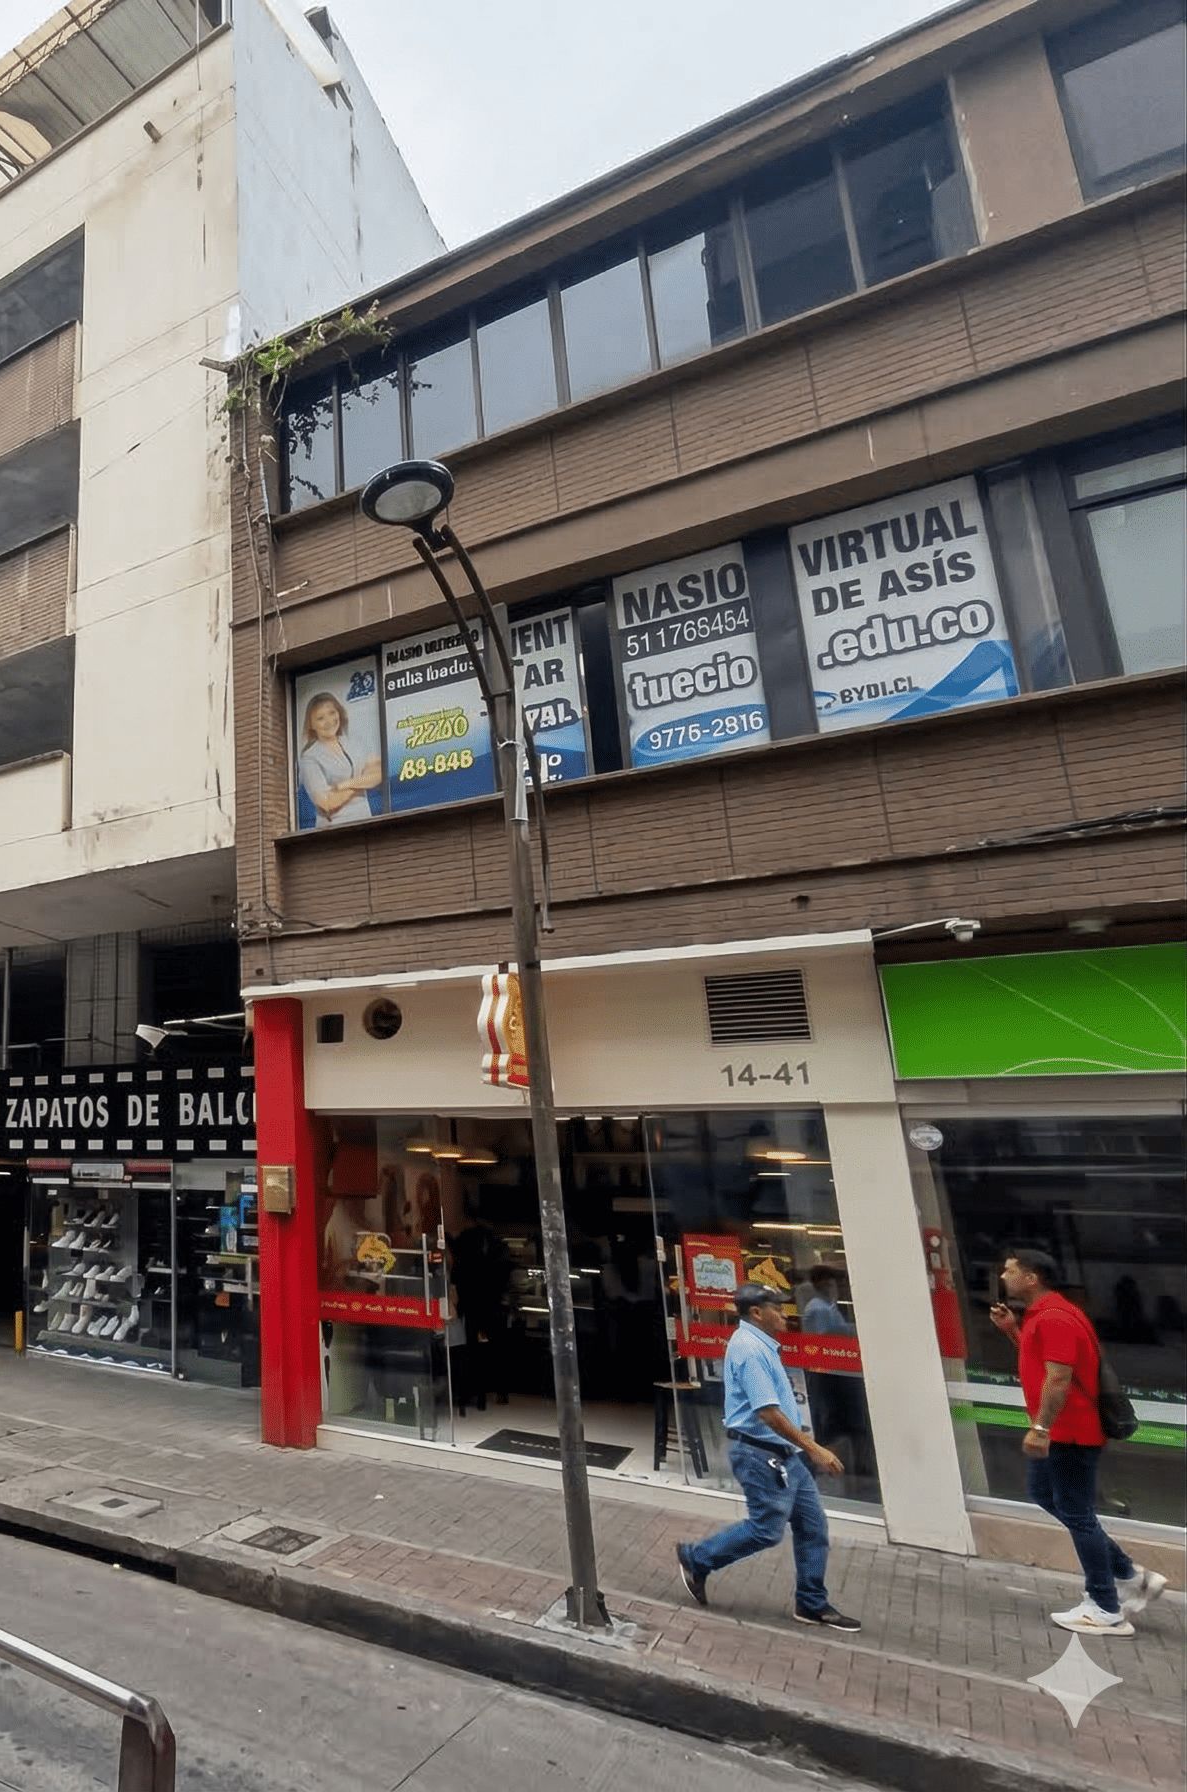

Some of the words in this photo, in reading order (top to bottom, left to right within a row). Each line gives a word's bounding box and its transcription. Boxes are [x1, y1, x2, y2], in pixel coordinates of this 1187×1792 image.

[797, 499, 979, 577] VIRTUAL
[622, 562, 746, 626] NASIO
[811, 578, 865, 617] DE
[878, 549, 976, 602] ASÍS
[819, 601, 993, 669] .edu.co
[629, 653, 756, 708] tuecio
[720, 1061, 810, 1087] 14-41
[5, 1095, 110, 1129] ZAPATOS
[127, 1093, 161, 1127] DE
[179, 1091, 257, 1126] BALC
